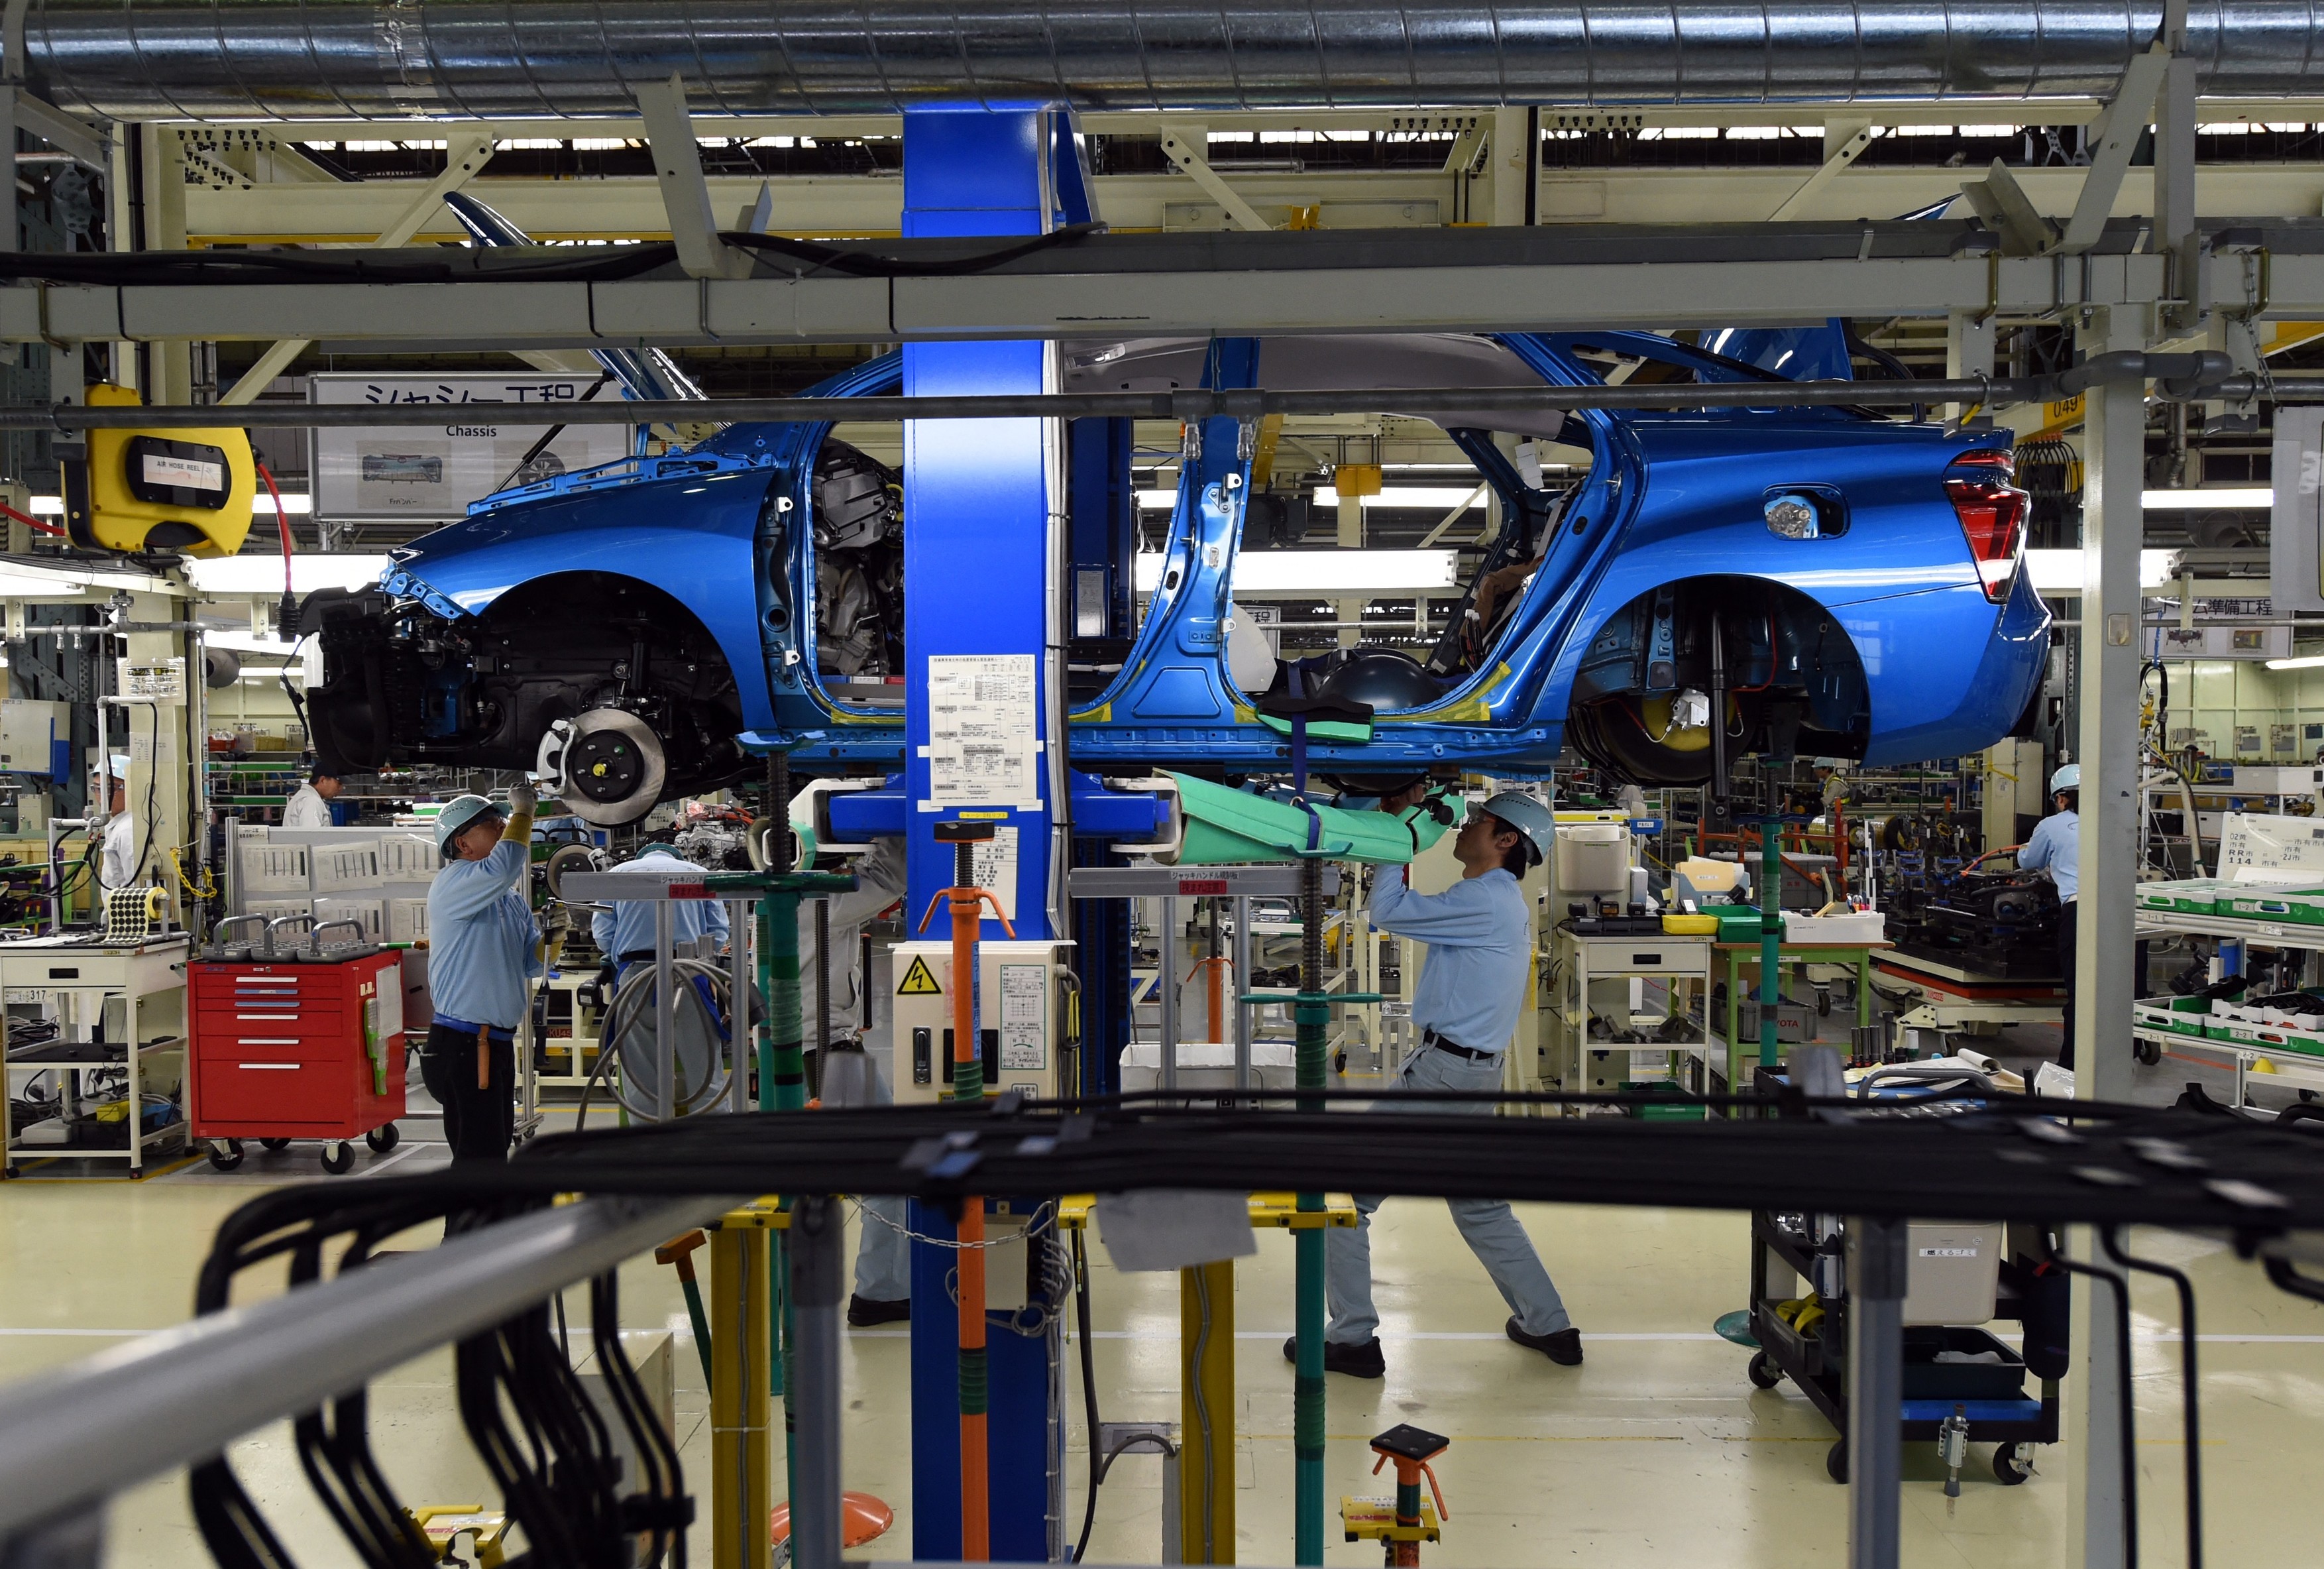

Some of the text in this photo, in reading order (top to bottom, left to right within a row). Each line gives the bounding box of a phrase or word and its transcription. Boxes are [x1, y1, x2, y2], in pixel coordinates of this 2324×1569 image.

[446, 424, 497, 437] Chassis
[2164, 599, 2273, 616] トム準備工程
[1246, 611, 1271, 623] 程
[2228, 856, 2252, 865] 114
[30, 990, 46, 1000] 317
